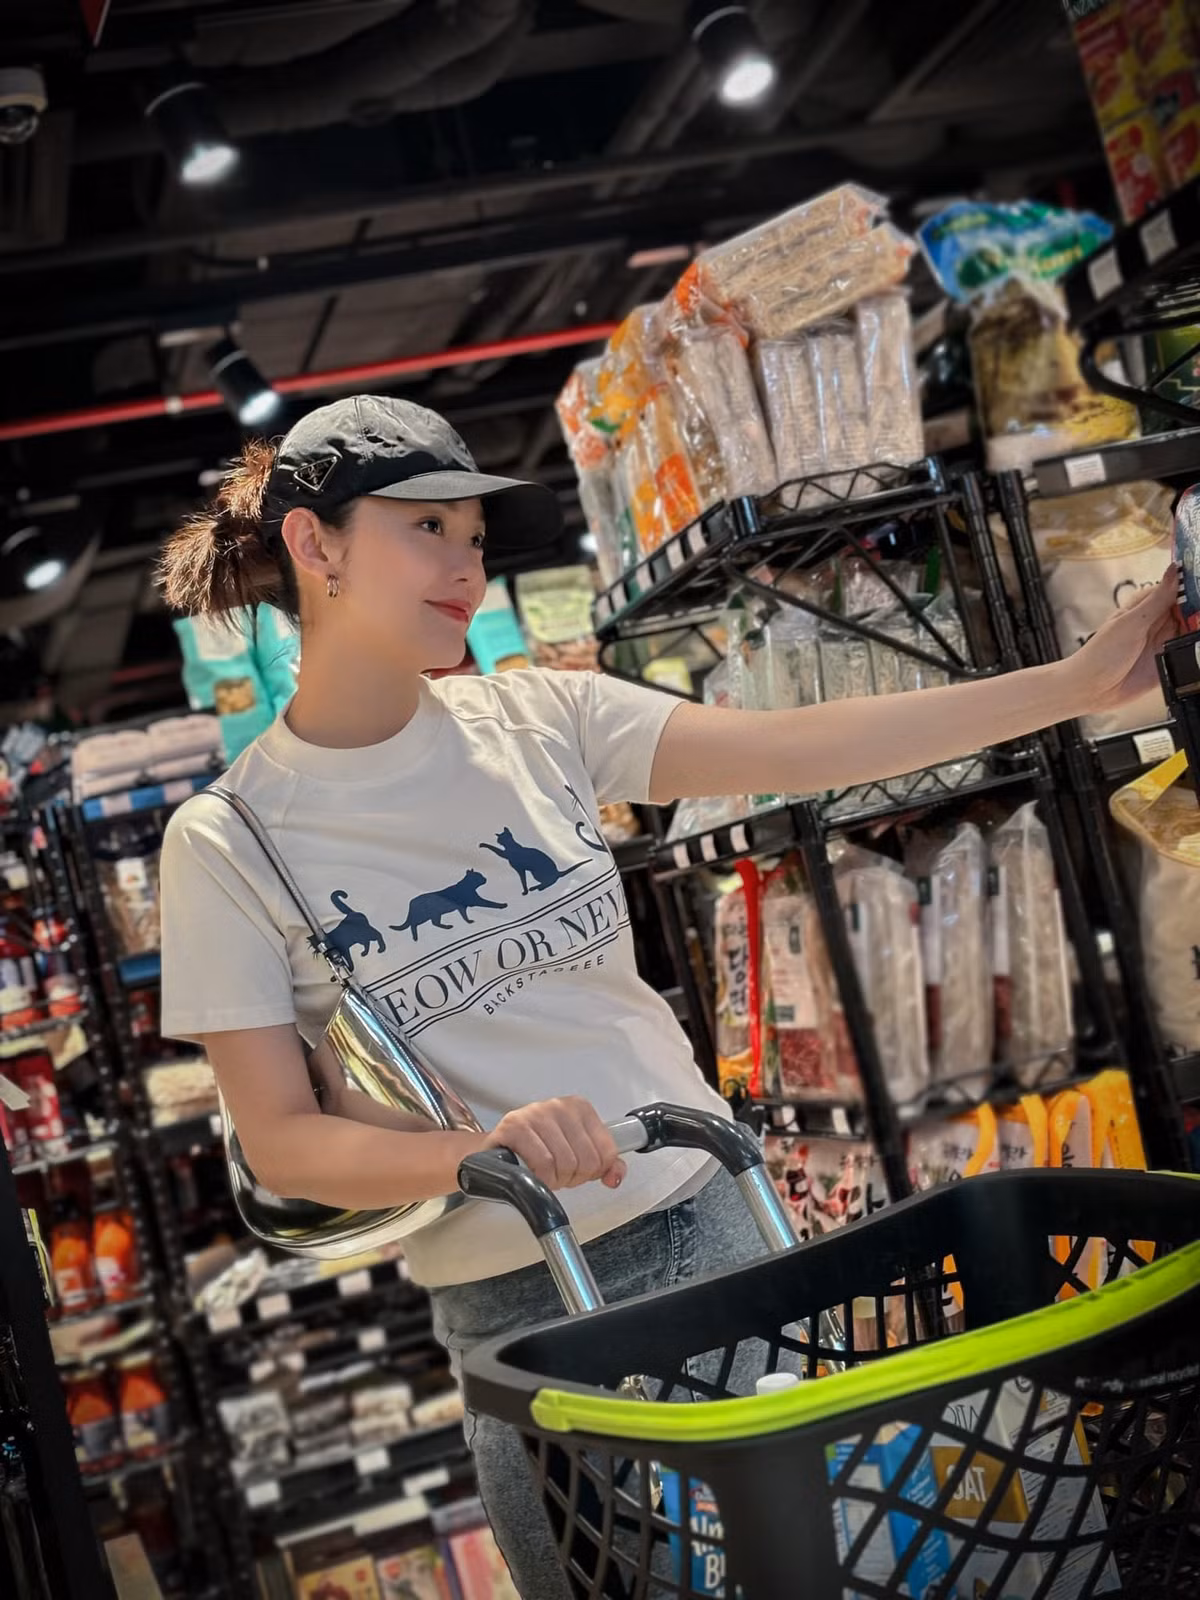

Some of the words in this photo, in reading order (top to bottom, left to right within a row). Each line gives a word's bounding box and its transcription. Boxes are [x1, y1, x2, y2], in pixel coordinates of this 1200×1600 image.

[374, 949, 482, 1027] EOW
[497, 929, 558, 970] OR
[554, 880, 629, 950] NEV
